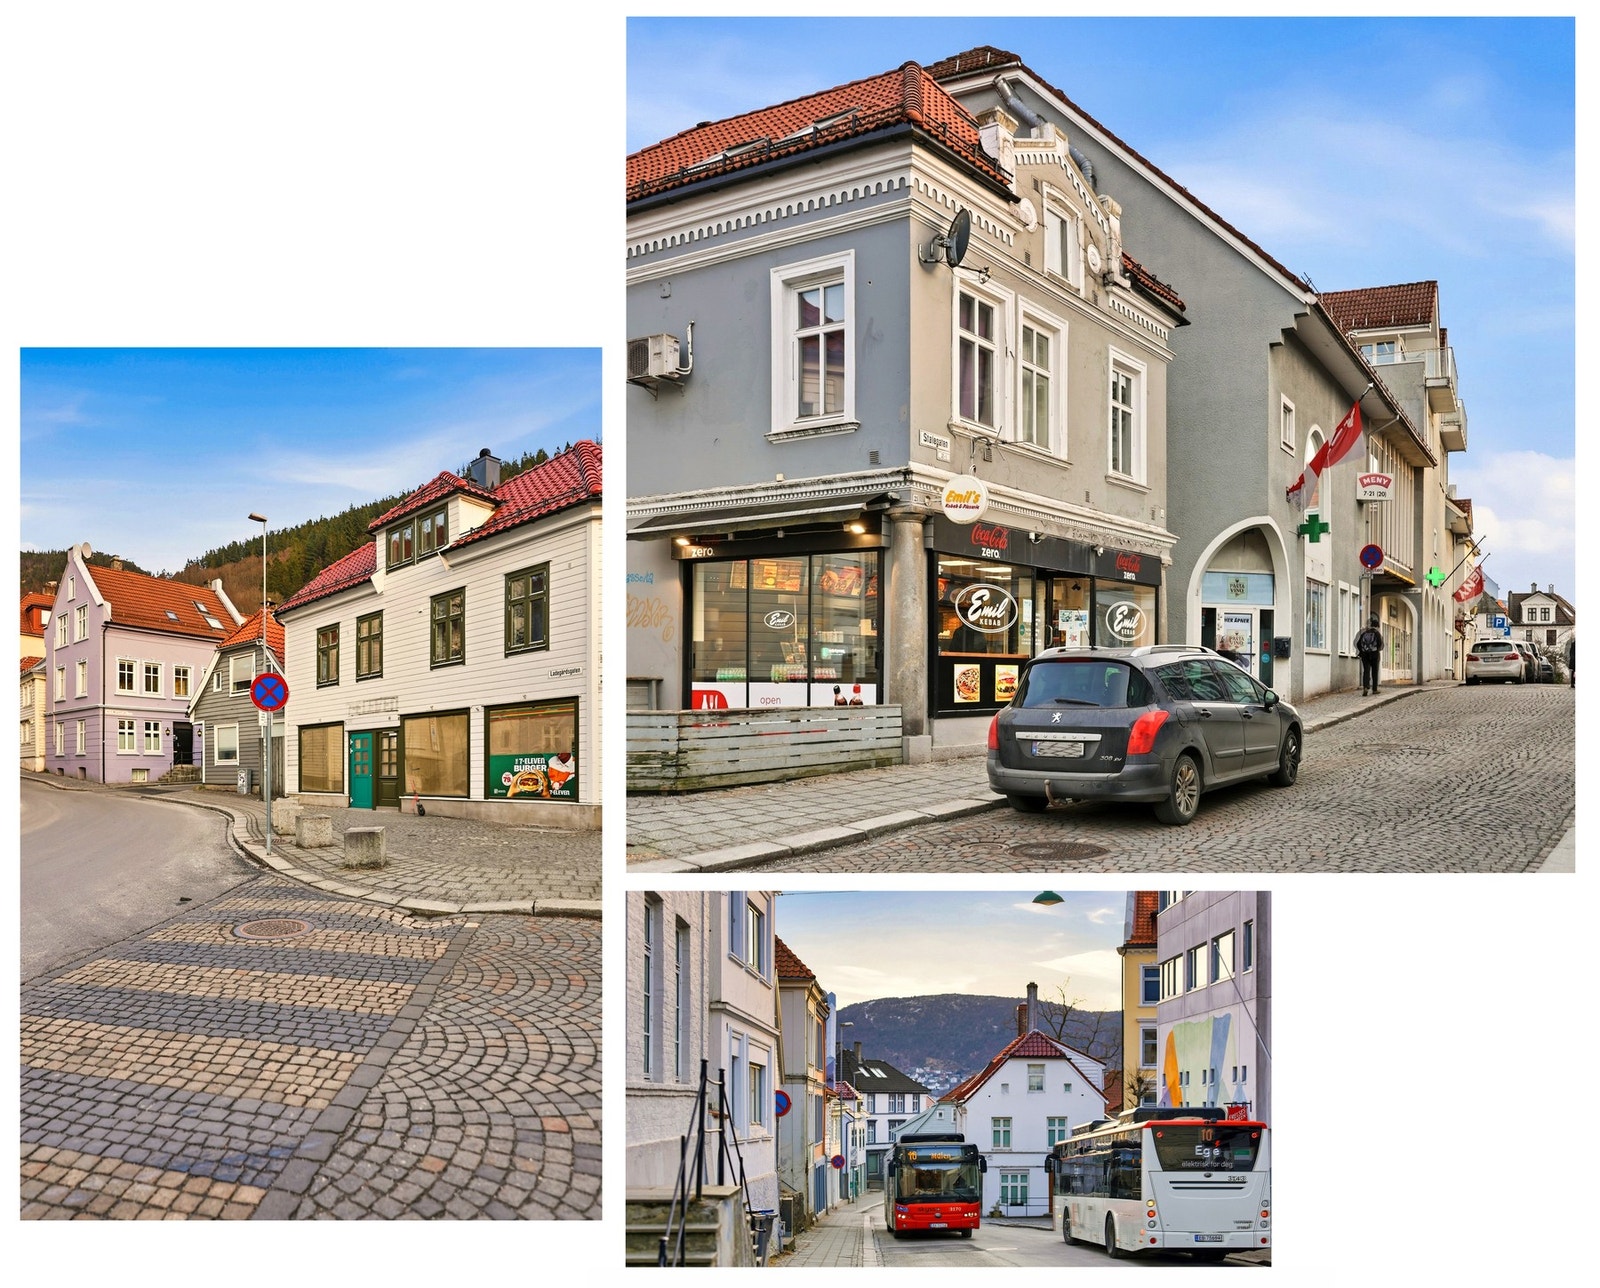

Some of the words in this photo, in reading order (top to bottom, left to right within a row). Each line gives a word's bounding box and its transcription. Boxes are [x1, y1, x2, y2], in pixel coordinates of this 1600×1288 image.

[1362, 476, 1389, 487] MENY
[946, 490, 981, 504] Emil's
[1377, 490, 1387, 498] (20)
[968, 589, 1009, 621] Emil
[979, 618, 1001, 627] KEBAB
[1114, 605, 1140, 632] Emil
[1496, 619, 1502, 627] P
[760, 697, 781, 705] open
[1201, 1129, 1213, 1141] 10
